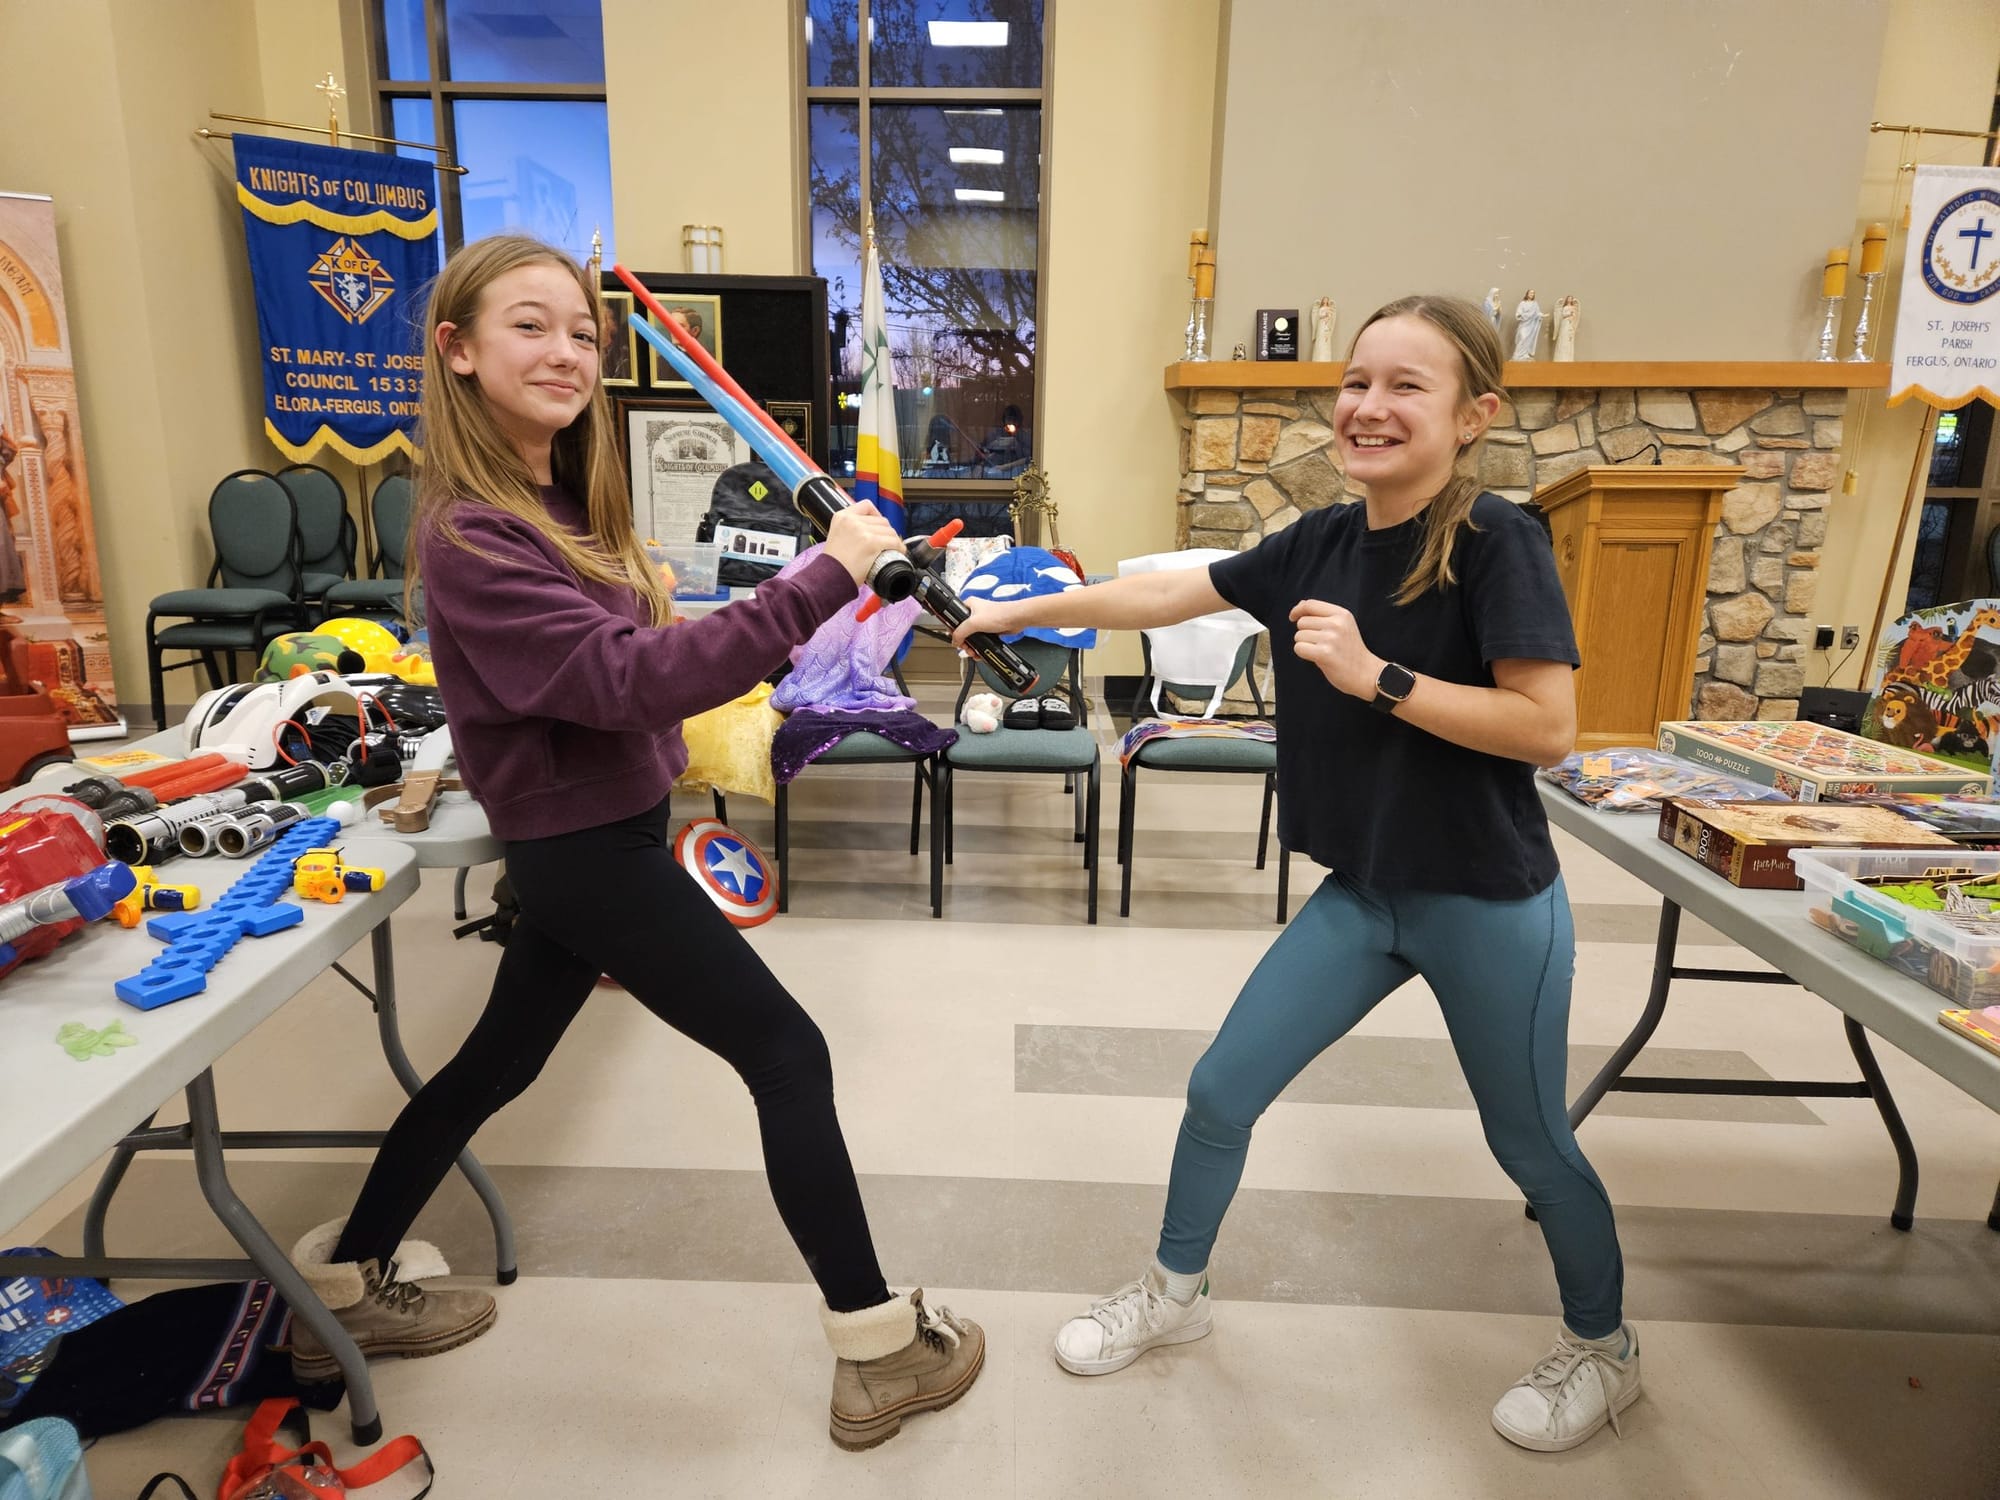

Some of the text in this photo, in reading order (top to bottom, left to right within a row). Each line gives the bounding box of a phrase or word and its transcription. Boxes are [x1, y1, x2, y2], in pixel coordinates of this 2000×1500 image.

[249, 166, 428, 211] KNIGHTS OF COLUMBUS
[1935, 192, 1975, 225] CATHOLIC
[331, 257, 370, 272] K OF C
[1926, 273, 1941, 289] FOR
[1942, 287, 1960, 300] GOD
[1927, 320, 1991, 333] ST. JOSEPH'S
[1941, 337, 1973, 349] PARISH
[271, 347, 292, 363] ST.
[354, 353, 376, 369] ST.
[1906, 355, 1997, 369] FERGUS, ONTARIO
[285, 372, 359, 391] COUNCIL
[274, 394, 425, 417] ELORA-FERGUS, ONTA
[1696, 748, 1714, 763] 1000
[1723, 758, 1751, 775] PUZZLE
[1698, 828, 1710, 860] 1000
[1770, 859, 1791, 871] Potter
